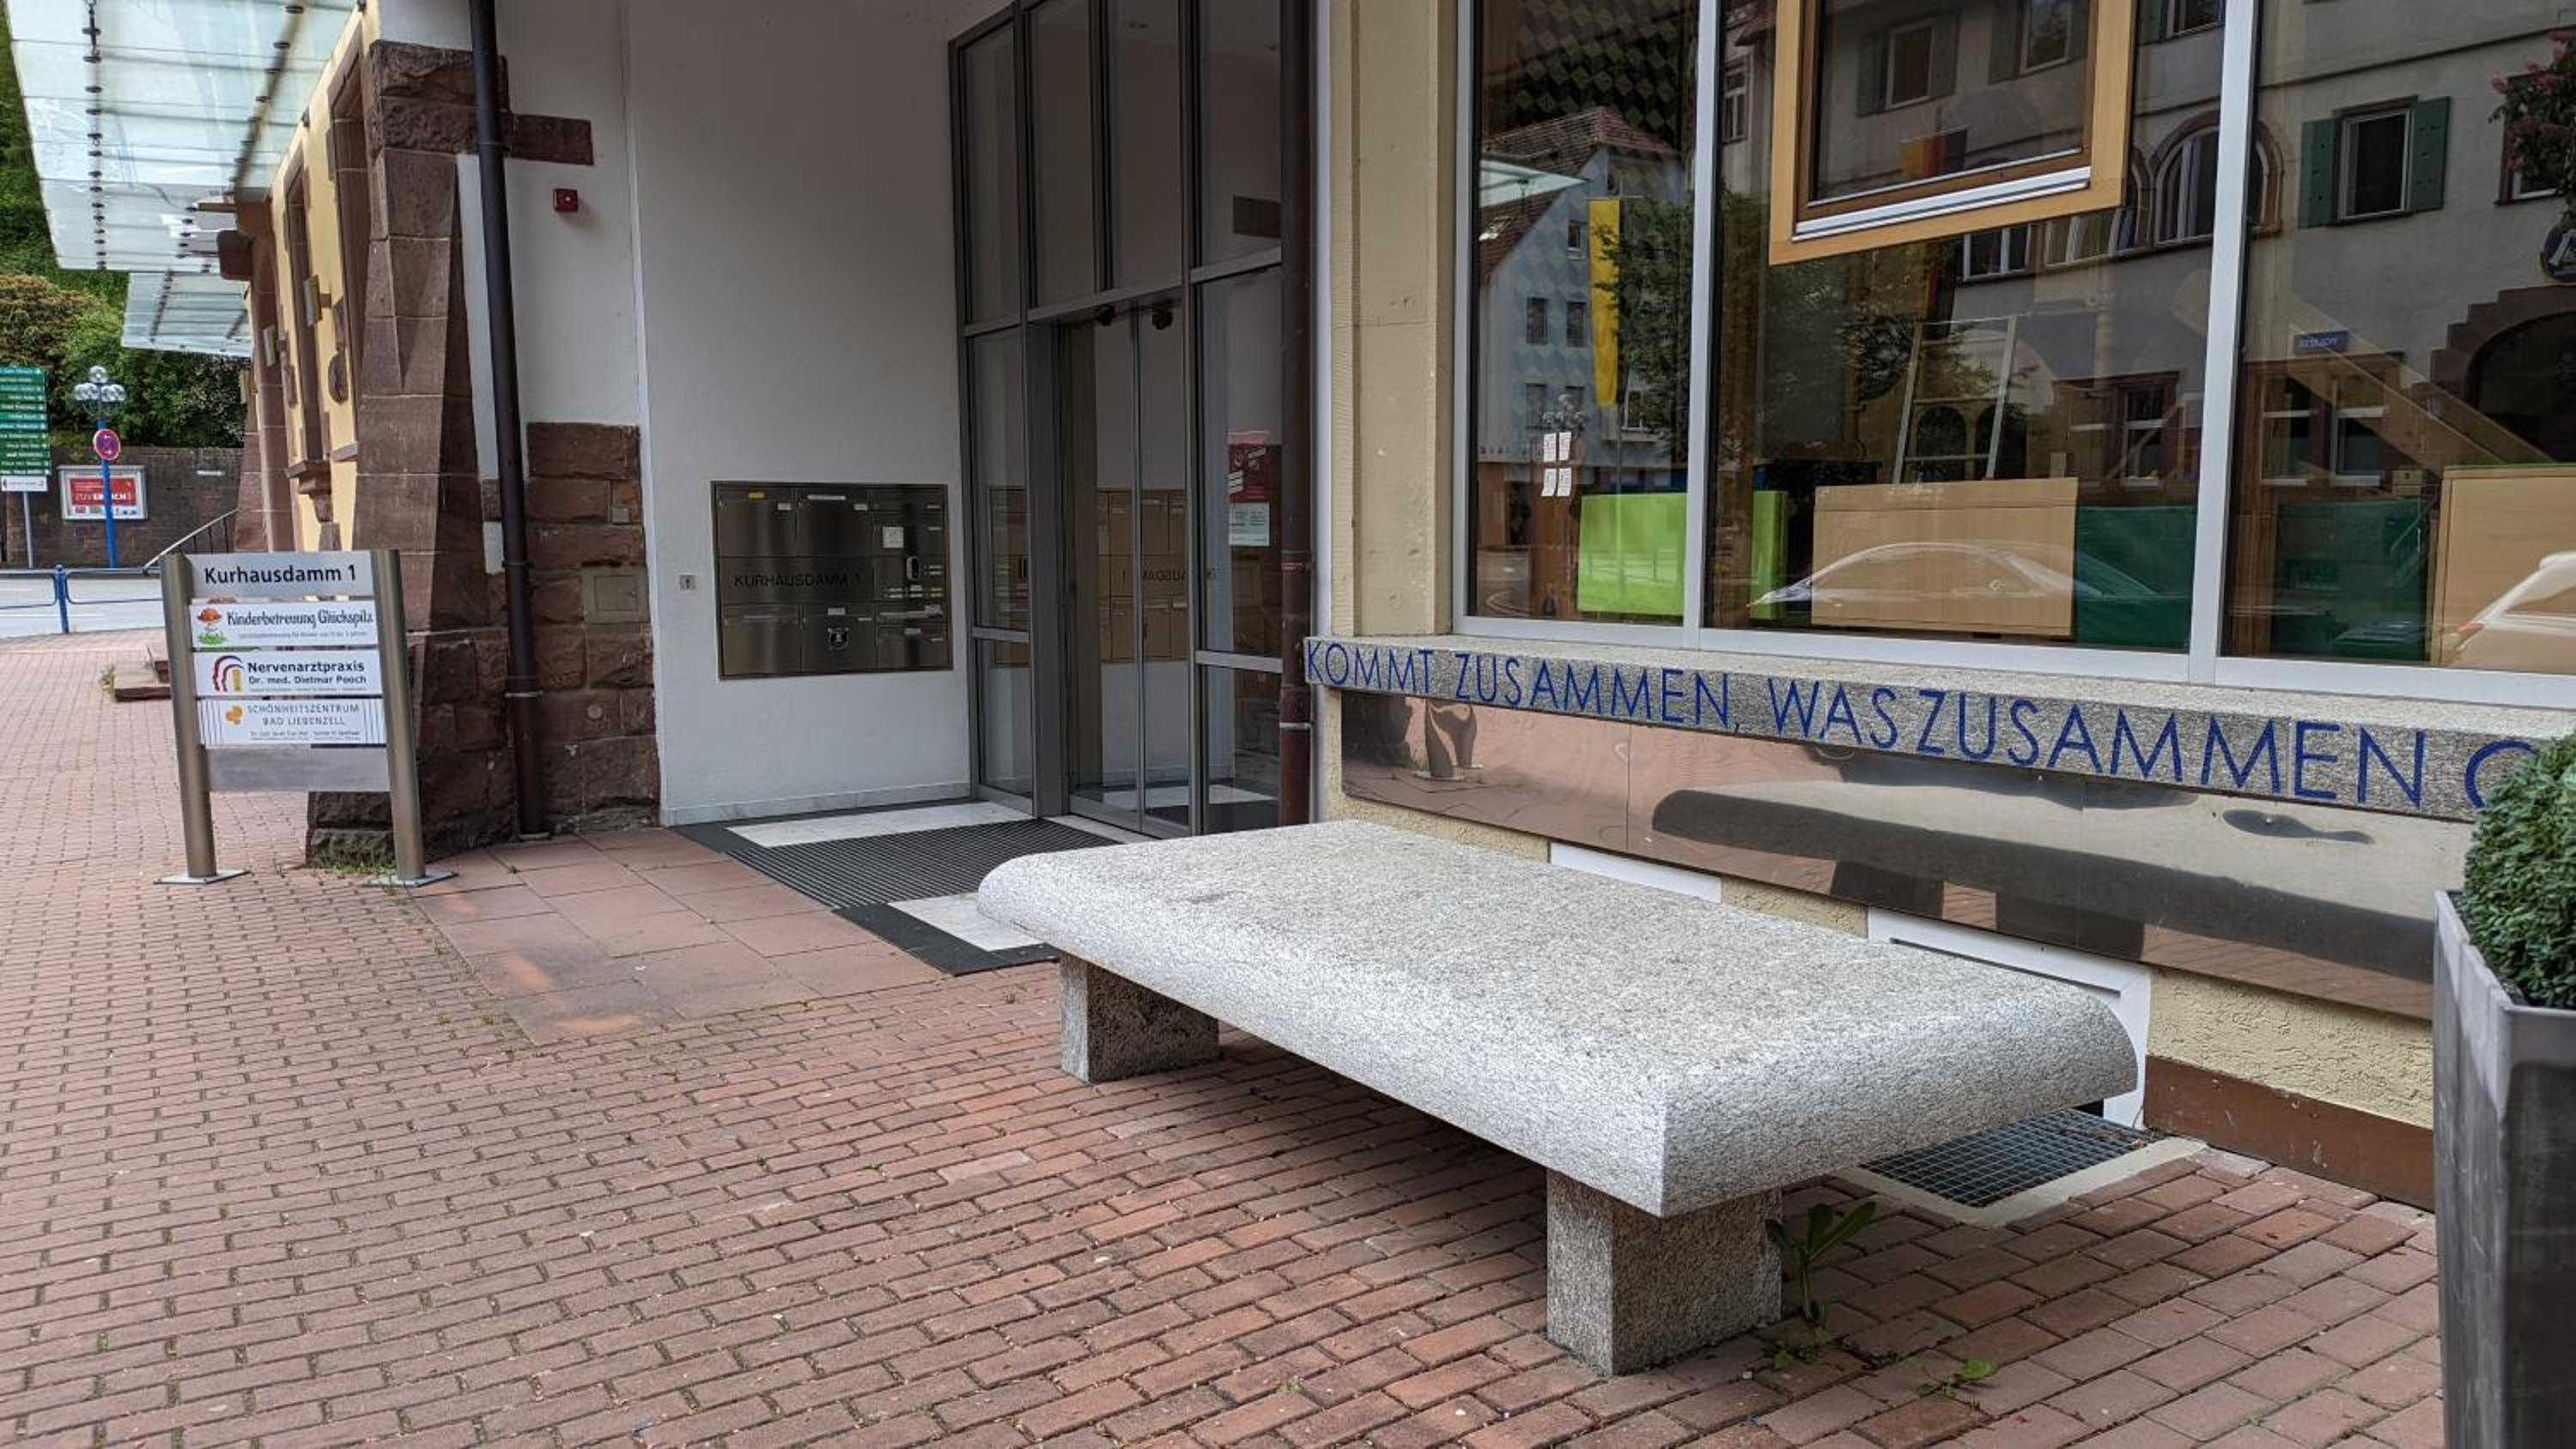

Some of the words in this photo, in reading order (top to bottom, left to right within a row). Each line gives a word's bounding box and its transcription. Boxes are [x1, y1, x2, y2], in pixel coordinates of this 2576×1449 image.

[204, 564, 342, 585] Kurhausdamm
[348, 564, 356, 581] 1
[734, 573, 848, 587] KURHAUSDAMM
[227, 610, 317, 629] Kinderbetreuung
[317, 608, 374, 628] Glückspilz
[247, 660, 365, 675] Nervenarztpraxis
[248, 676, 264, 685] Dr.
[267, 675, 291, 685] med.
[294, 675, 333, 684] Dietmar
[1307, 641, 1433, 694] KOMMT
[1455, 651, 1740, 734] ZUSAMMEN,
[246, 703, 360, 714] SCHÖNHEITSZENTRUM
[262, 716, 284, 726] BAD
[288, 716, 345, 725] LIEBENZELL
